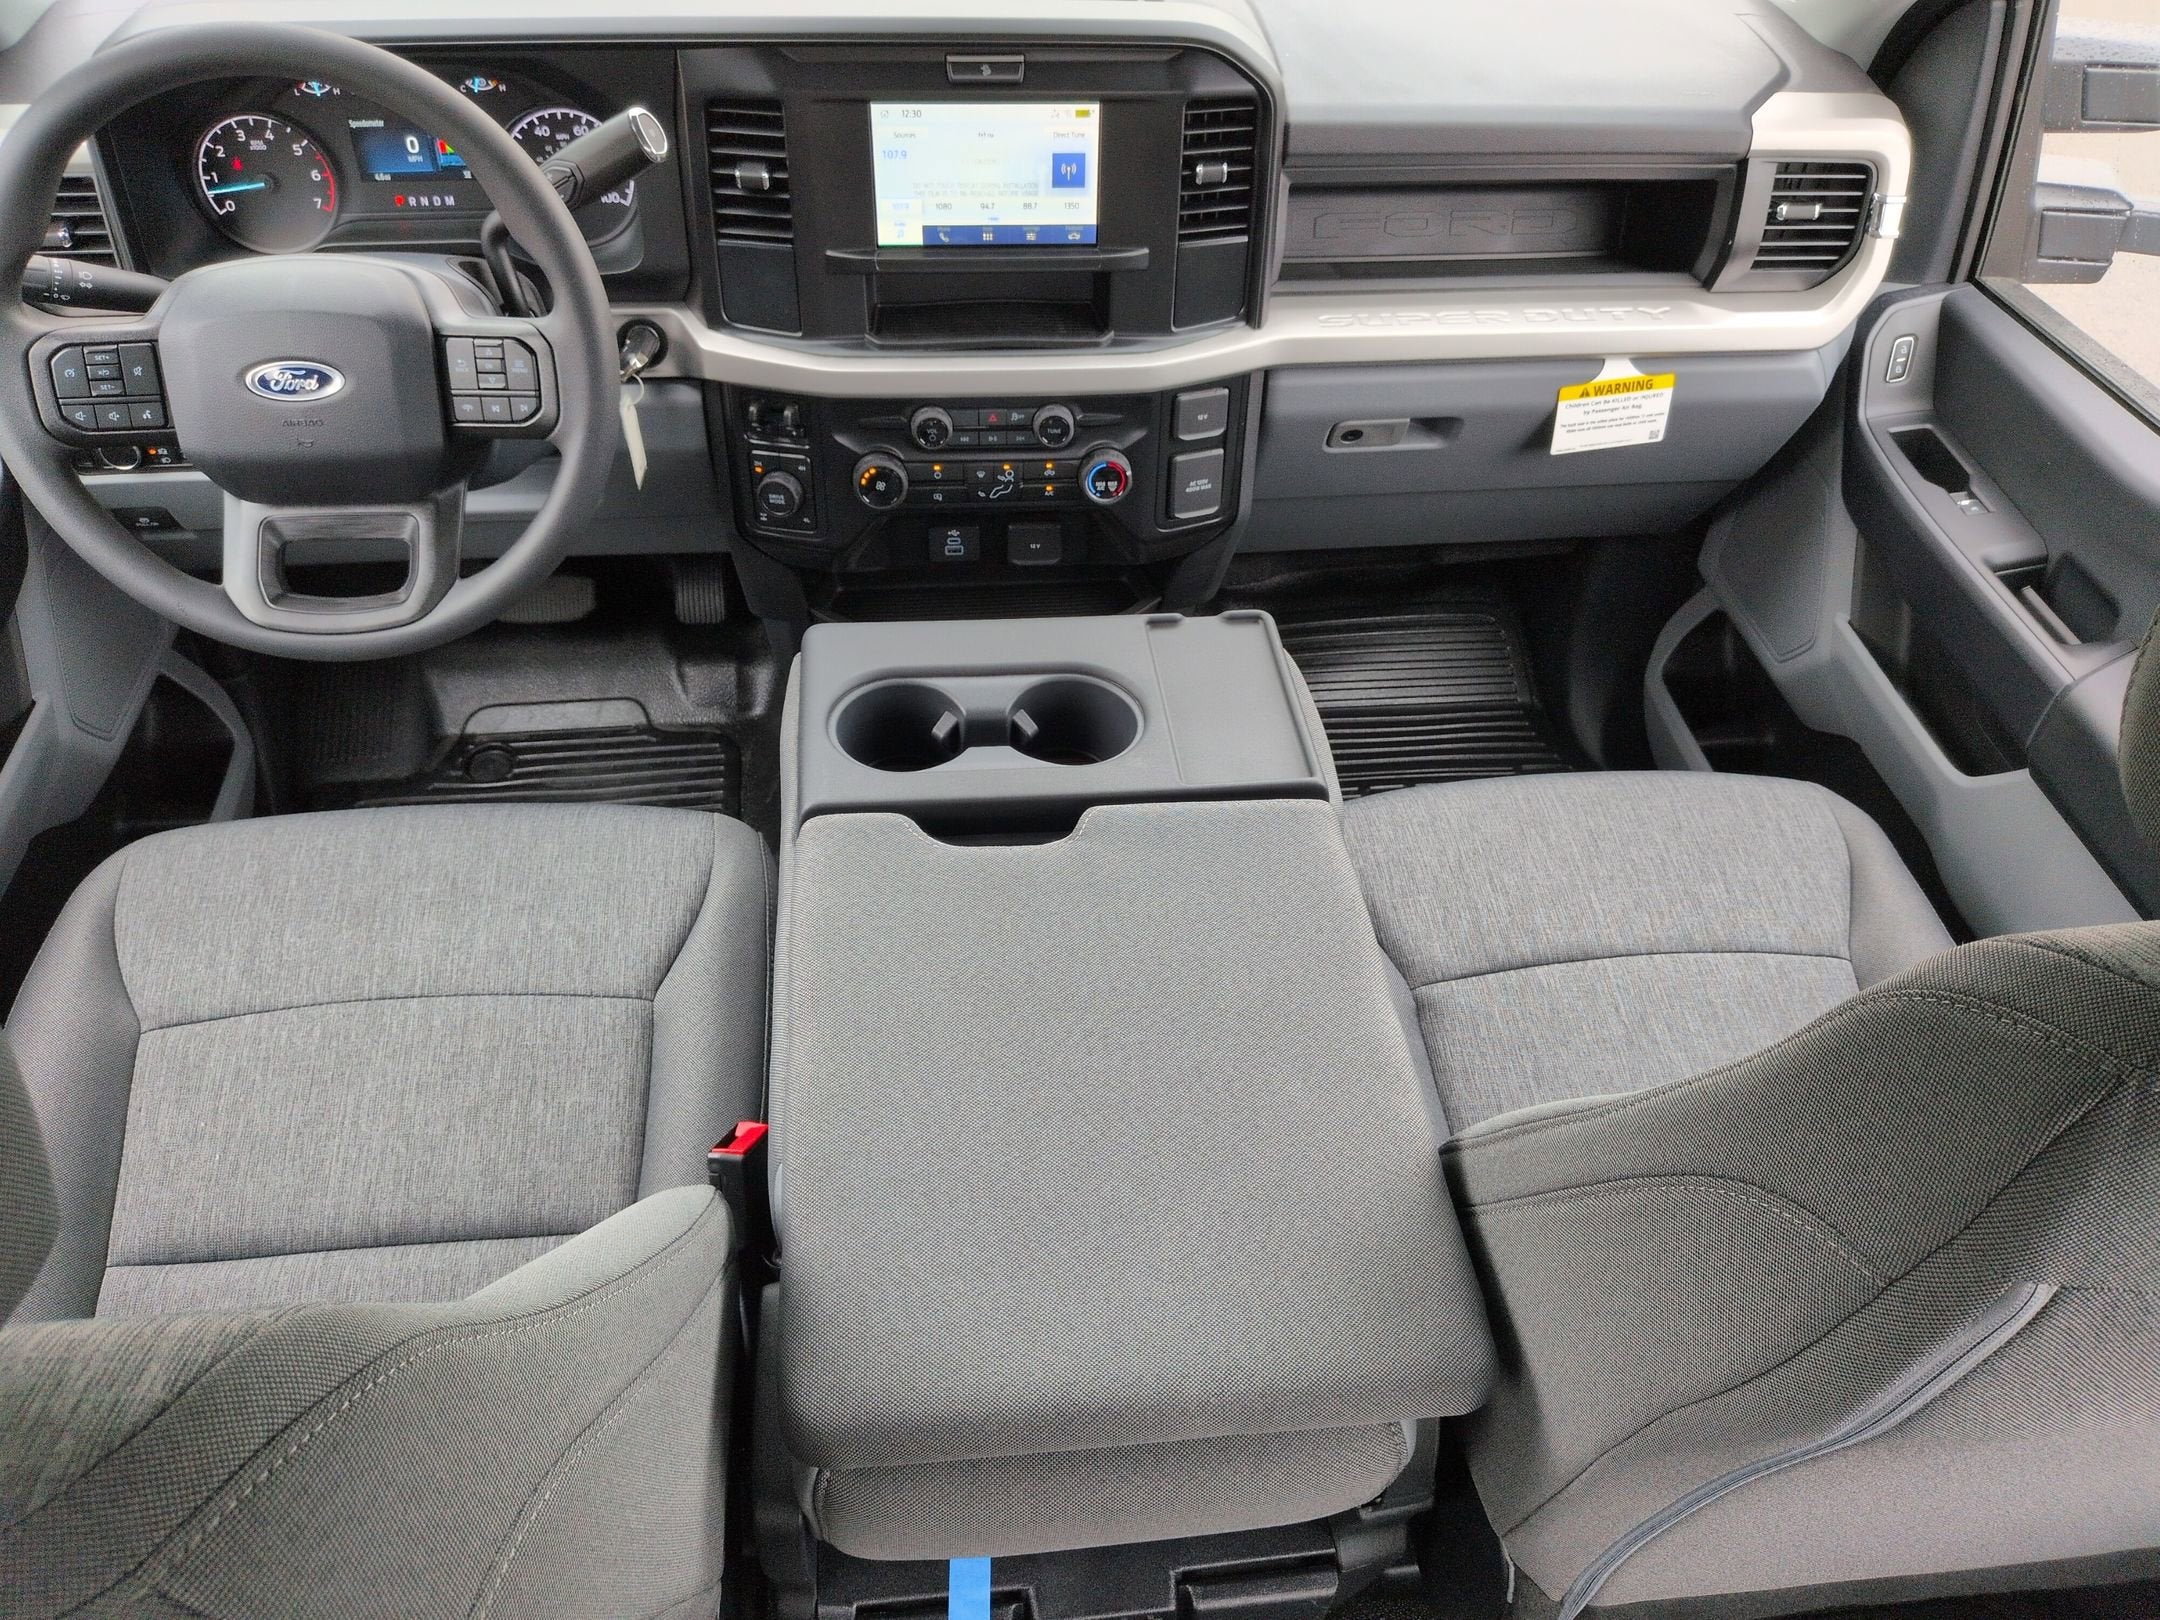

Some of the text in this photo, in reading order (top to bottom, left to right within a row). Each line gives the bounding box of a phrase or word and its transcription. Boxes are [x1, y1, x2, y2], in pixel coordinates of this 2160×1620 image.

[294, 88, 300, 96] L
[333, 87, 341, 95] H
[460, 85, 467, 93] C
[901, 109, 922, 119] 12:30
[235, 129, 246, 142] 3
[265, 130, 275, 141] 4
[534, 125, 551, 138] 40
[573, 124, 590, 137] 60
[215, 145, 226, 158] 2
[292, 143, 303, 156] 5
[405, 136, 420, 155] 0
[882, 149, 908, 160] 107.9
[211, 171, 218, 183] 1
[310, 169, 321, 182] 6
[225, 200, 236, 212] 0
[313, 198, 322, 210] 7
[408, 195, 417, 207] R
[420, 196, 430, 207] N
[432, 195, 442, 206] D
[444, 195, 456, 206] M
[1313, 208, 1578, 239] FORD
[1318, 306, 1672, 328] SUPER DUTY
[269, 368, 320, 393] Ford
[1593, 378, 1654, 397] WARNING
[1565, 401, 1590, 410] Children
[1592, 405, 1621, 415] Passenger
